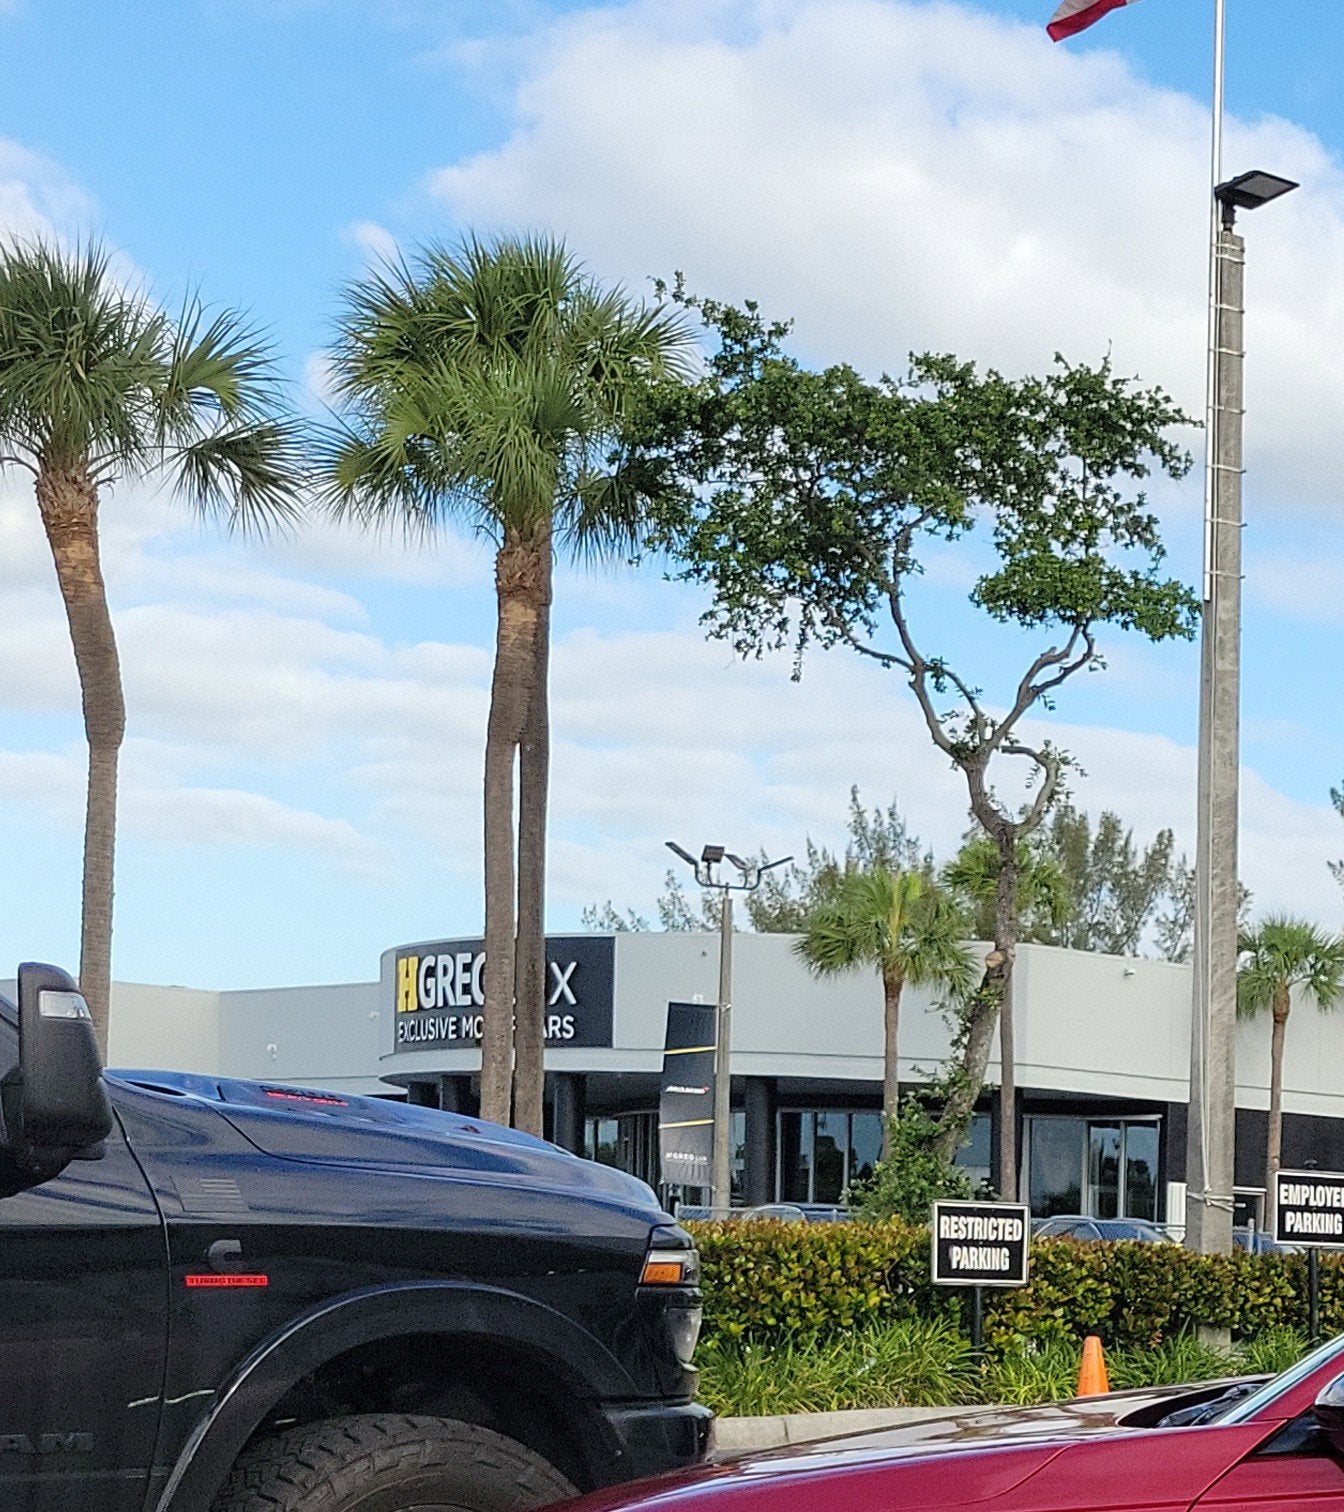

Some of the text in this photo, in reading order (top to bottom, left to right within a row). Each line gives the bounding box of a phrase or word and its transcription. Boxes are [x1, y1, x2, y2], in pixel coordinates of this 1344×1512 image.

[399, 1016, 457, 1042] EXCLUSIVE
[940, 1215, 1023, 1241] RESTRICTED
[1285, 1211, 1343, 1235] PARKING
[951, 1246, 1010, 1271] PARKING
